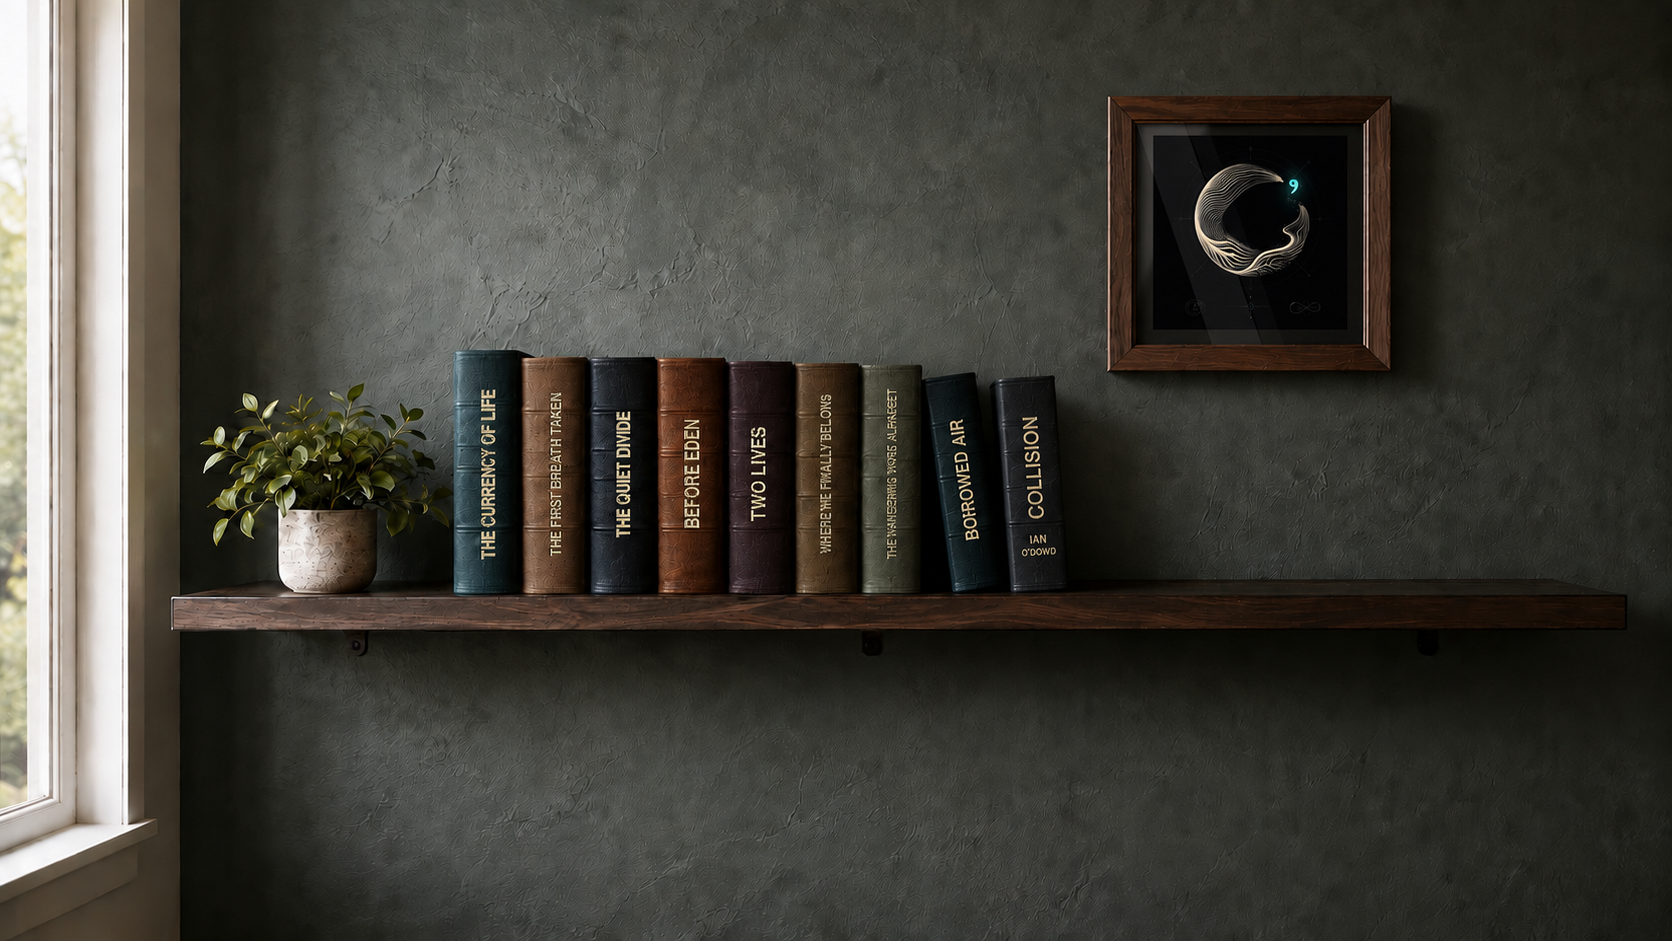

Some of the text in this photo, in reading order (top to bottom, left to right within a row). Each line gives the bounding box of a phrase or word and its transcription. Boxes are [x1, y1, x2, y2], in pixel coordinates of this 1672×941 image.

[550, 392, 562, 435] TAKEN
[481, 389, 496, 559] THE CURRENCY OF LIFE
[616, 411, 631, 538] THE QUIET DIVIDE
[684, 420, 700, 528] BEFORE EDEN
[751, 427, 766, 521] TWO LIVES
[949, 419, 980, 541] BORROWED AIR
[1022, 416, 1045, 519] COLLISION
[550, 492, 562, 527] FIRST
[550, 531, 562, 556] THE
[1030, 534, 1047, 545] IAN
[887, 539, 897, 560] THE
[1022, 547, 1057, 557] O'DOWD
